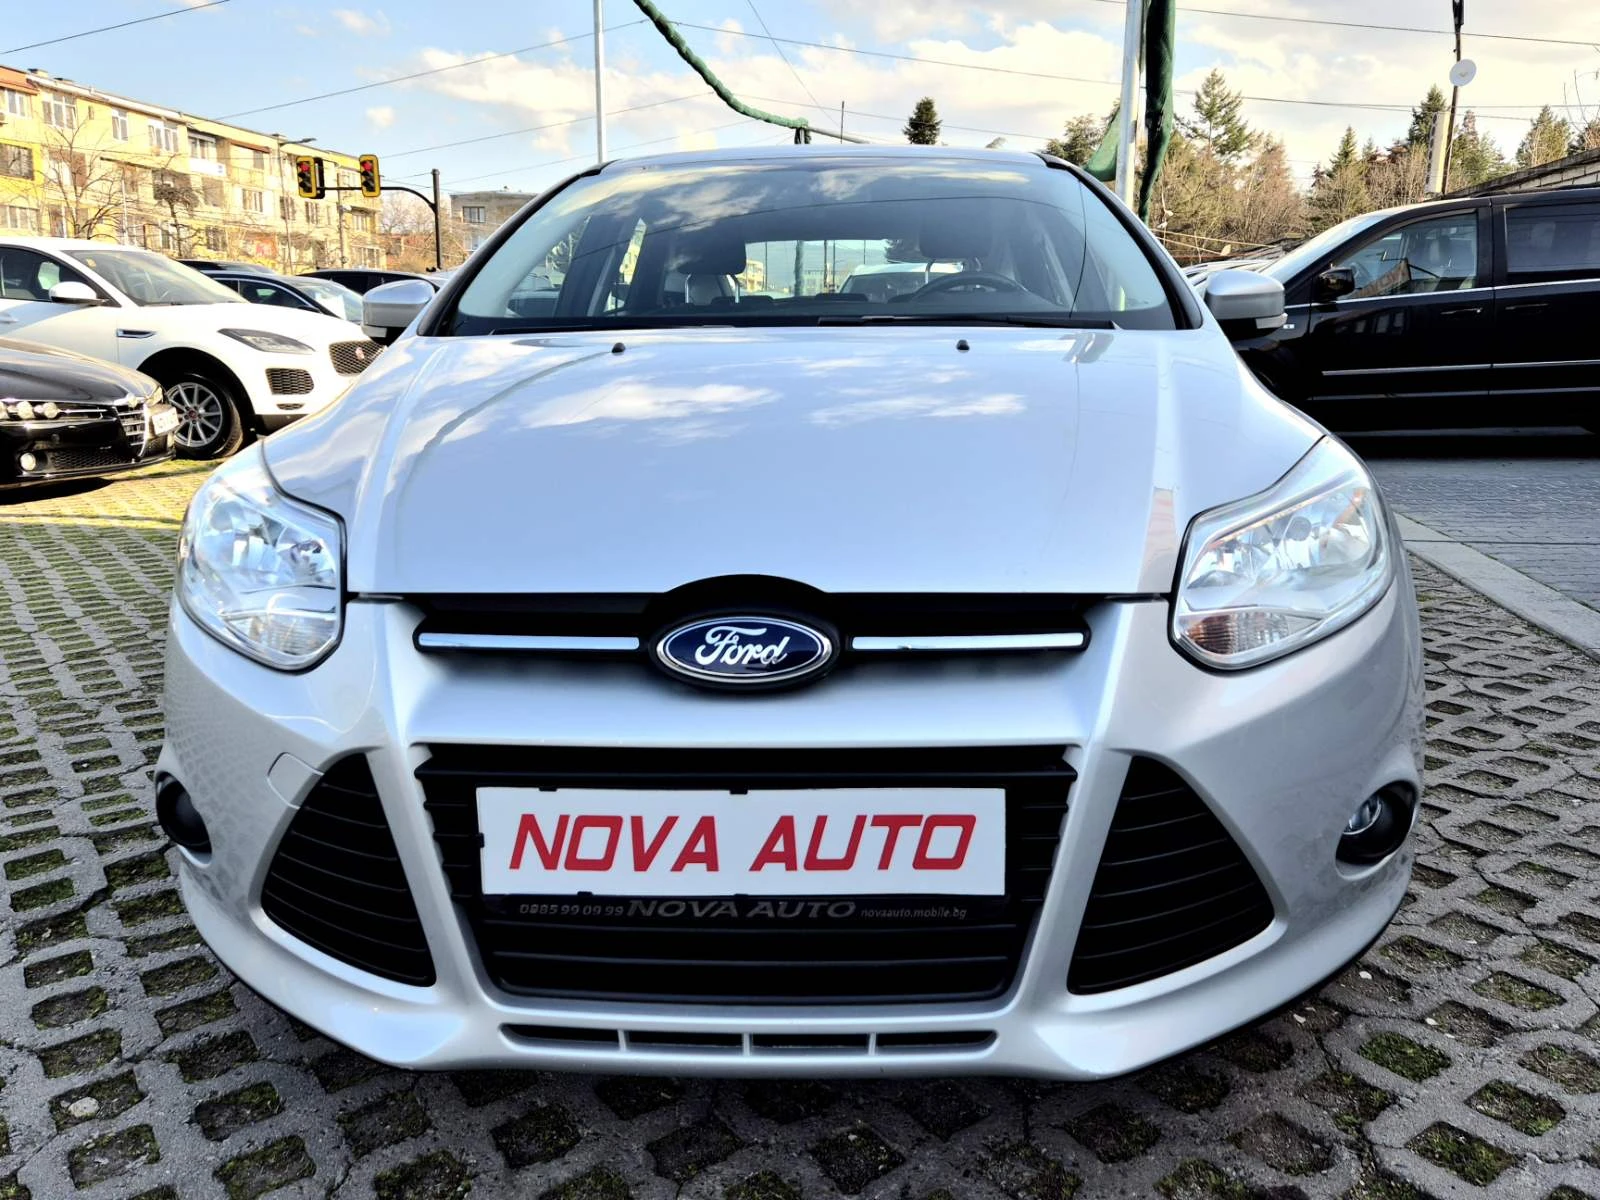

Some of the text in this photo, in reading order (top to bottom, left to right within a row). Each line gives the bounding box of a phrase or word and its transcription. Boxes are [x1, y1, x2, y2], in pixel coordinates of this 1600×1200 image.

[695, 625, 790, 665] Ford
[509, 813, 977, 872] NOVA AUTO
[519, 899, 967, 920] 0885 99 09 99 NOVA AUTO novaauto.mobile.bg
